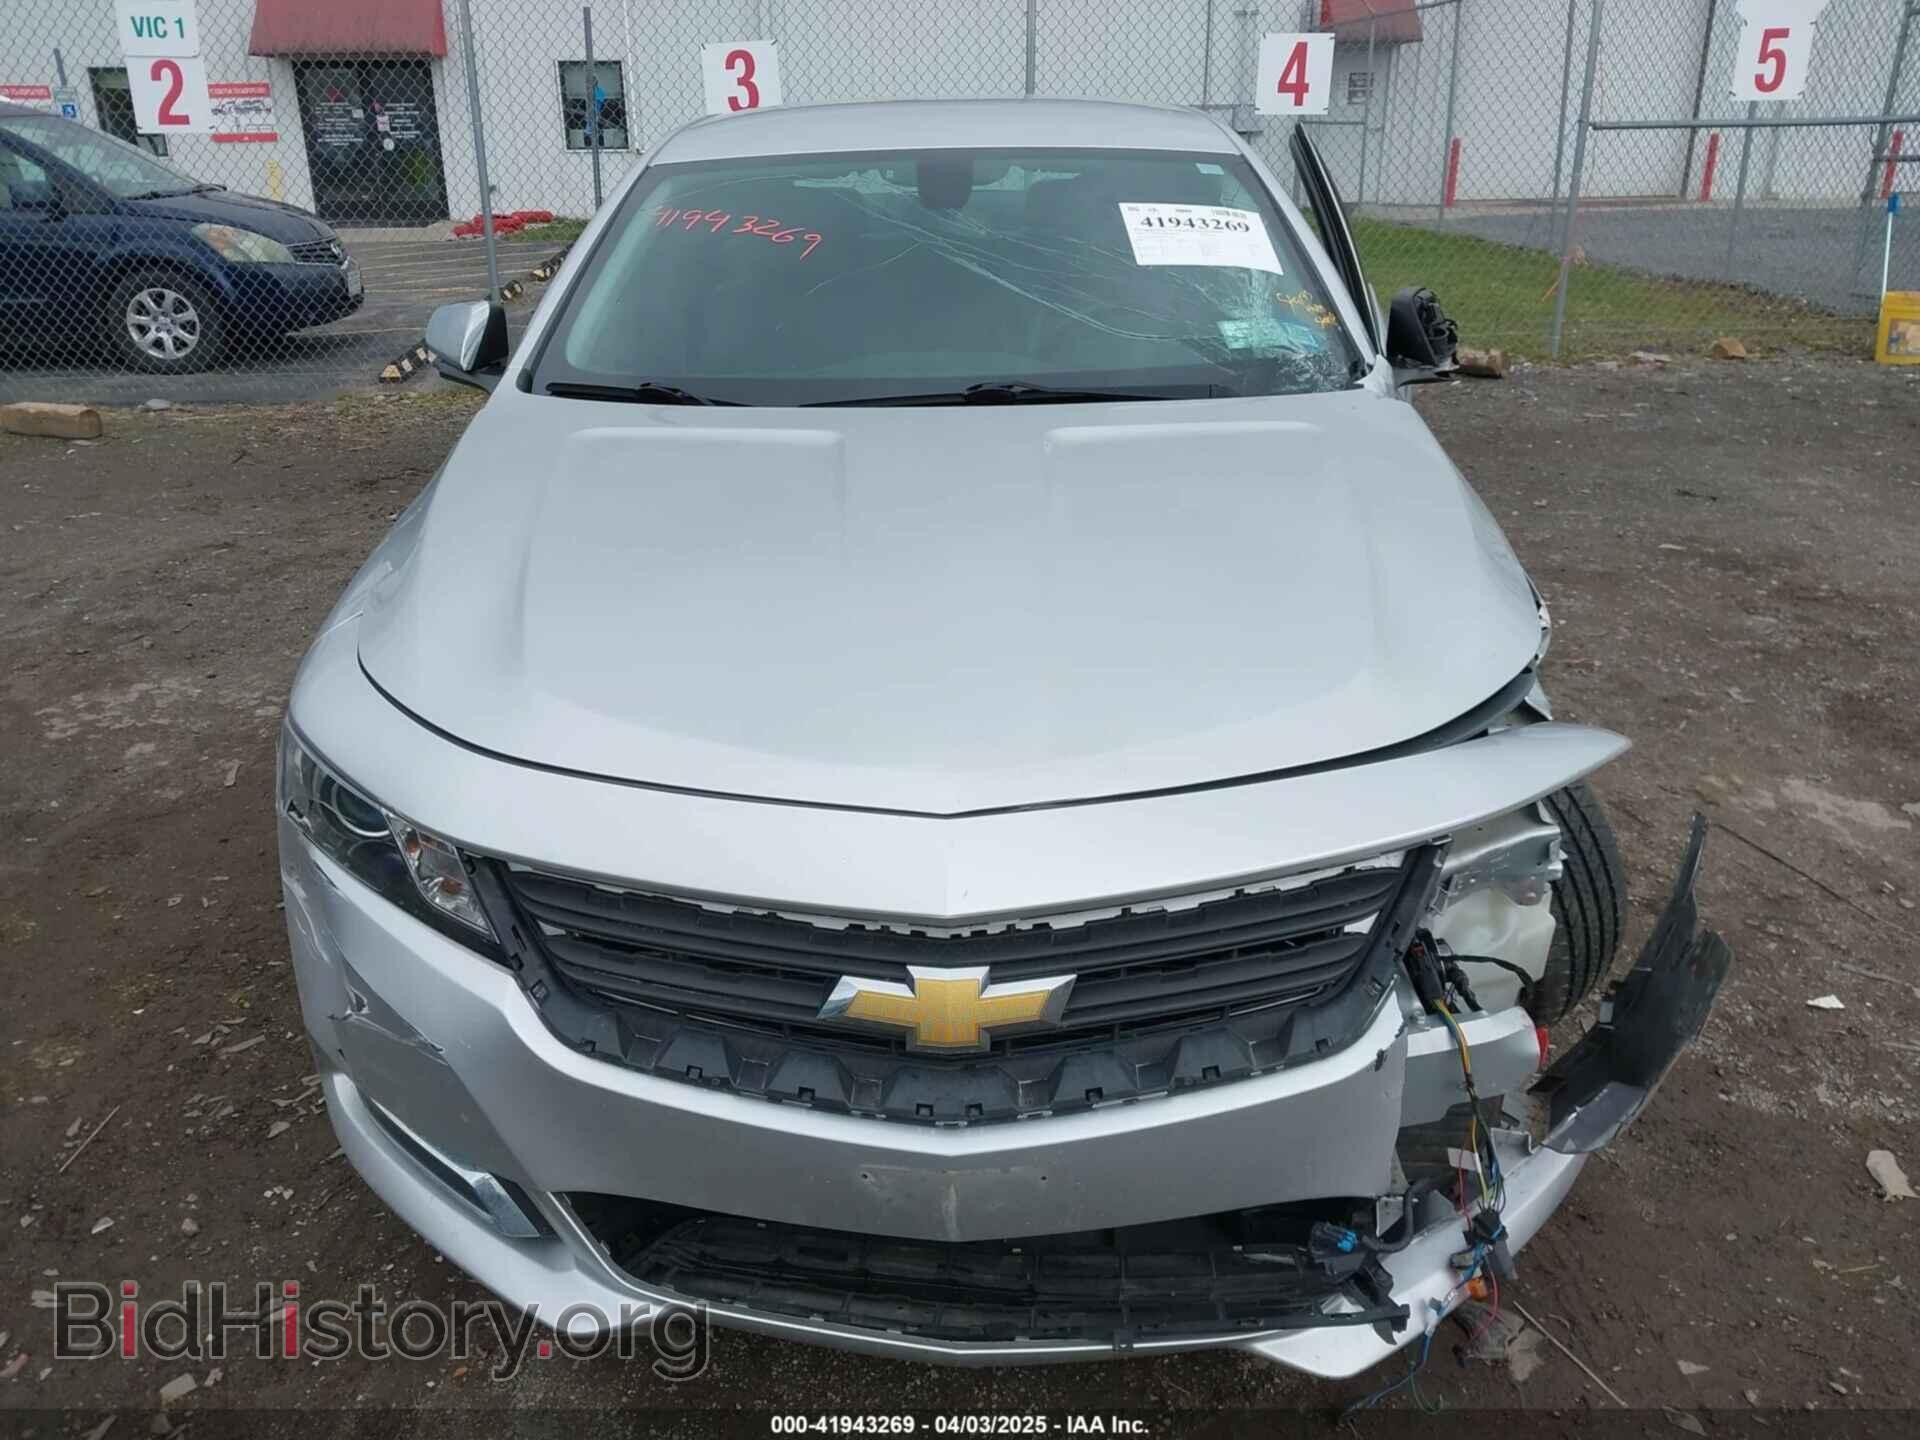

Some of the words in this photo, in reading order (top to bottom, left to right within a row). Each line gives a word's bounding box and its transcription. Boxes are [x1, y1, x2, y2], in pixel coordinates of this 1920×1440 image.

[130, 15, 168, 39] VIC
[173, 16, 185, 39] 1
[150, 59, 190, 125] 2
[725, 49, 760, 112] 3
[1277, 41, 1310, 106] 4
[1754, 27, 1790, 93] 5
[1140, 215, 1251, 233] 41943269
